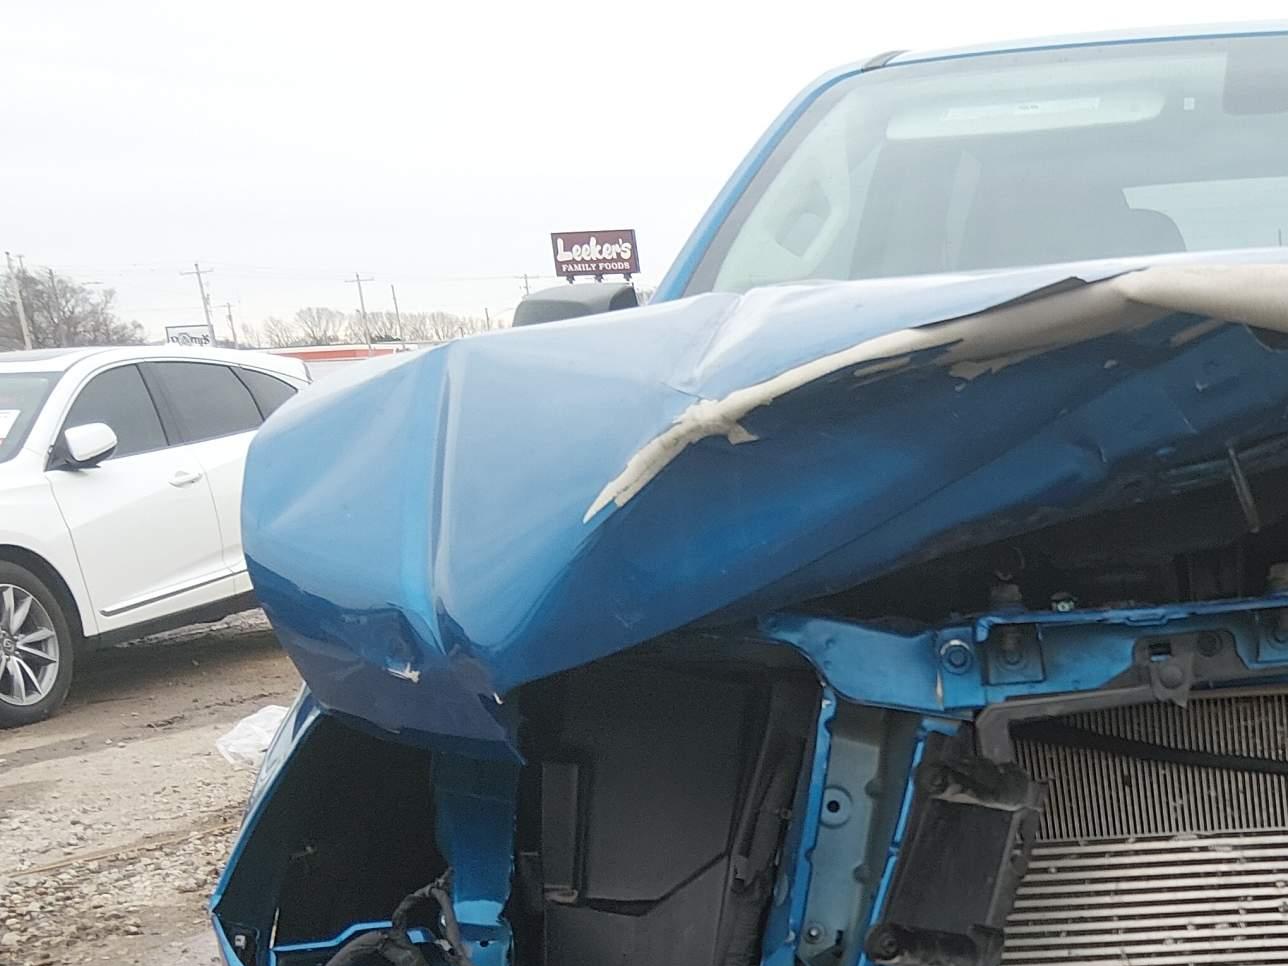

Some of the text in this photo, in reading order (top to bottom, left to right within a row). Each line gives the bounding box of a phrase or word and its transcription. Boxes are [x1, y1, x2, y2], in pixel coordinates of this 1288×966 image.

[557, 237, 632, 262] Leeker's
[562, 261, 631, 272] FAMILY FOODS
